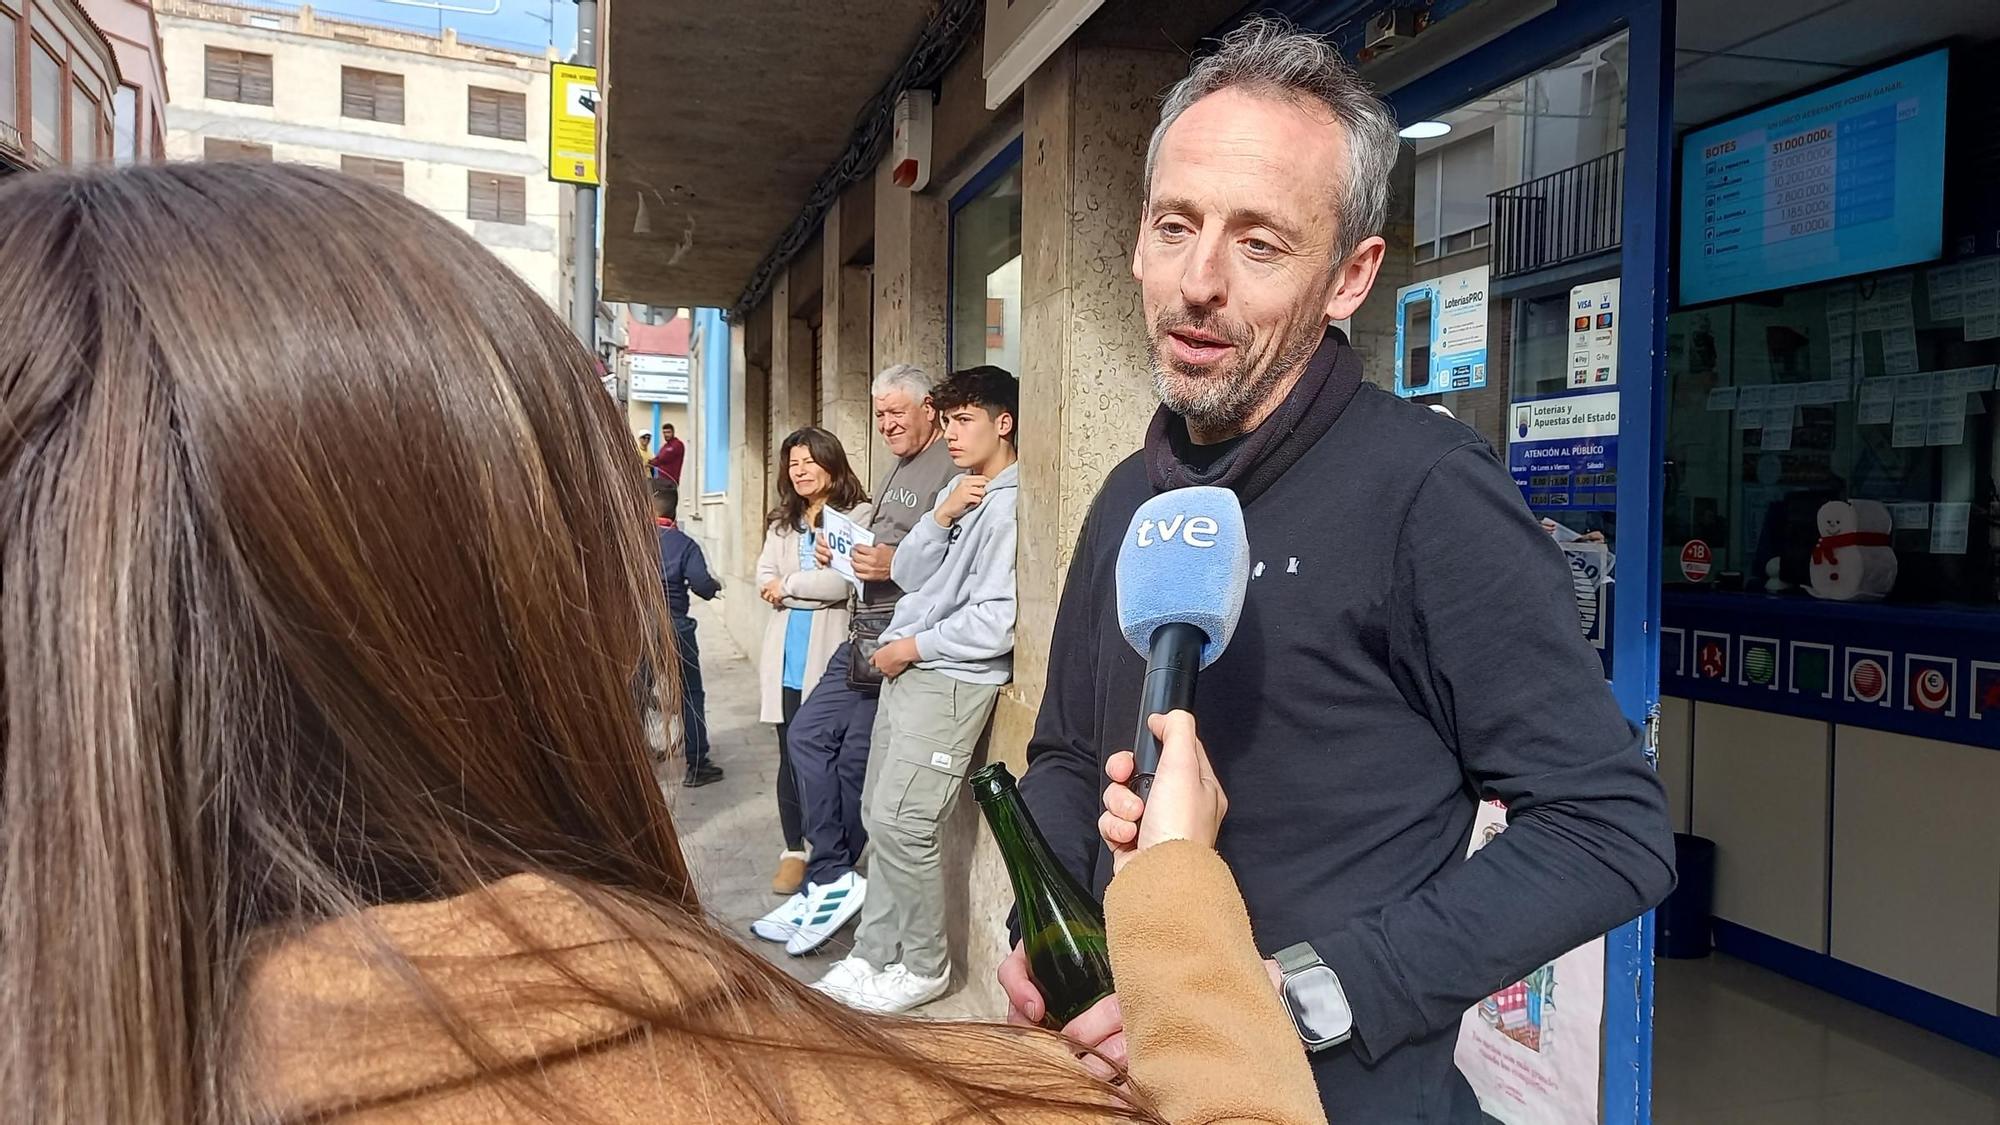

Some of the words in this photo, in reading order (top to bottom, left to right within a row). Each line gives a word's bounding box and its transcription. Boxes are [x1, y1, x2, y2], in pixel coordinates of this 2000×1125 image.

[1705, 140, 1736, 159] BOTES
[1577, 299, 1592, 309] VISA
[1567, 405, 1573, 415] y
[1534, 417, 1570, 429] Apuestas
[1572, 413, 1585, 424] del
[1587, 411, 1616, 423] Estado
[1524, 448, 1560, 458] ATENCIÓN
[1560, 448, 1571, 456] AL
[1572, 445, 1604, 455] PÚBLICO
[1553, 463, 1570, 471] Viernes
[1136, 512, 1219, 548] tve
[828, 532, 852, 554] 06
[1687, 545, 1705, 558] +18
